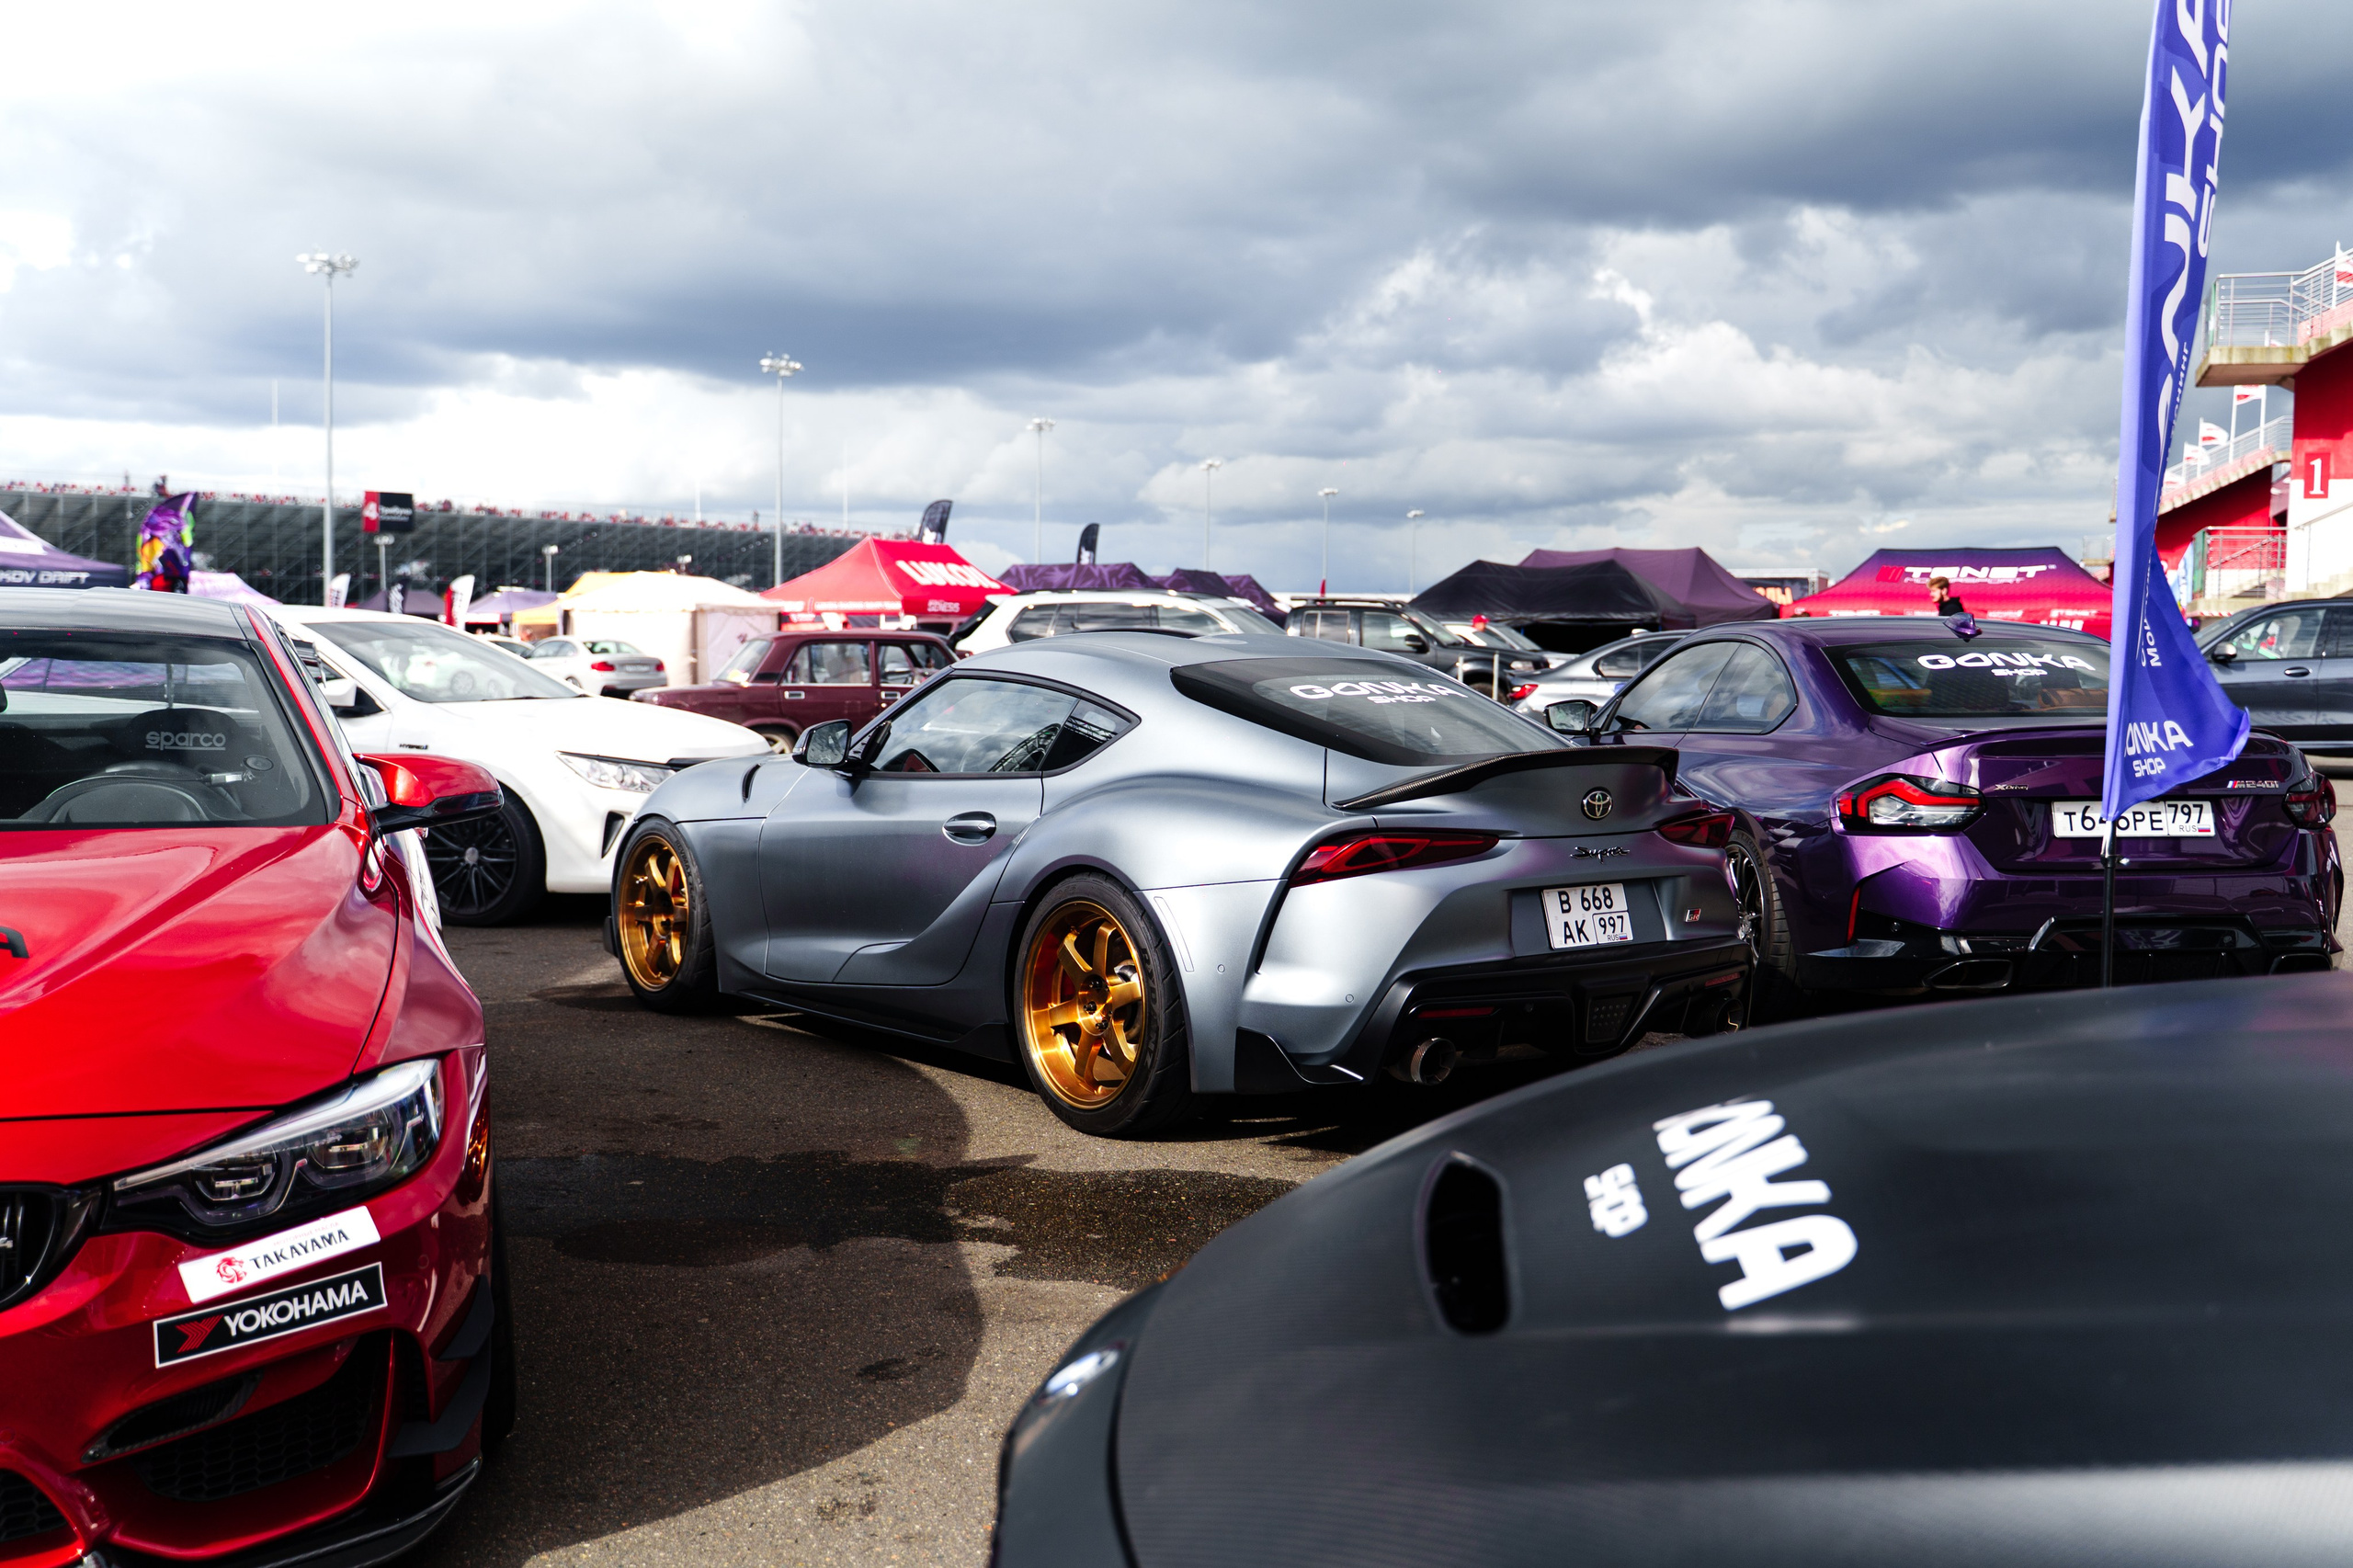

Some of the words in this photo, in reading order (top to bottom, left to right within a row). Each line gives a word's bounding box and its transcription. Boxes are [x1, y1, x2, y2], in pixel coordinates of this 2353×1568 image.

[2309, 458, 2325, 494] 1
[38, 571, 90, 584] DRIFT
[1917, 652, 2096, 671] GONKA
[1991, 668, 2048, 676] SHOP
[1290, 681, 1468, 699] GONKA
[1367, 695, 1436, 704] SHOP
[145, 731, 226, 751] sparco
[2132, 757, 2166, 778] SHOP
[2167, 804, 2204, 824] 797
[2179, 824, 2197, 833] RUS
[1570, 846, 1630, 864] Supra
[1557, 891, 1572, 914] B
[1580, 887, 1614, 912] 668
[1563, 919, 1590, 945] AK
[1598, 915, 1624, 935] 997
[1607, 934, 1620, 942] RUS
[249, 1229, 350, 1270] TAKAYAMA
[224, 1279, 369, 1337] YOKOHAMA
